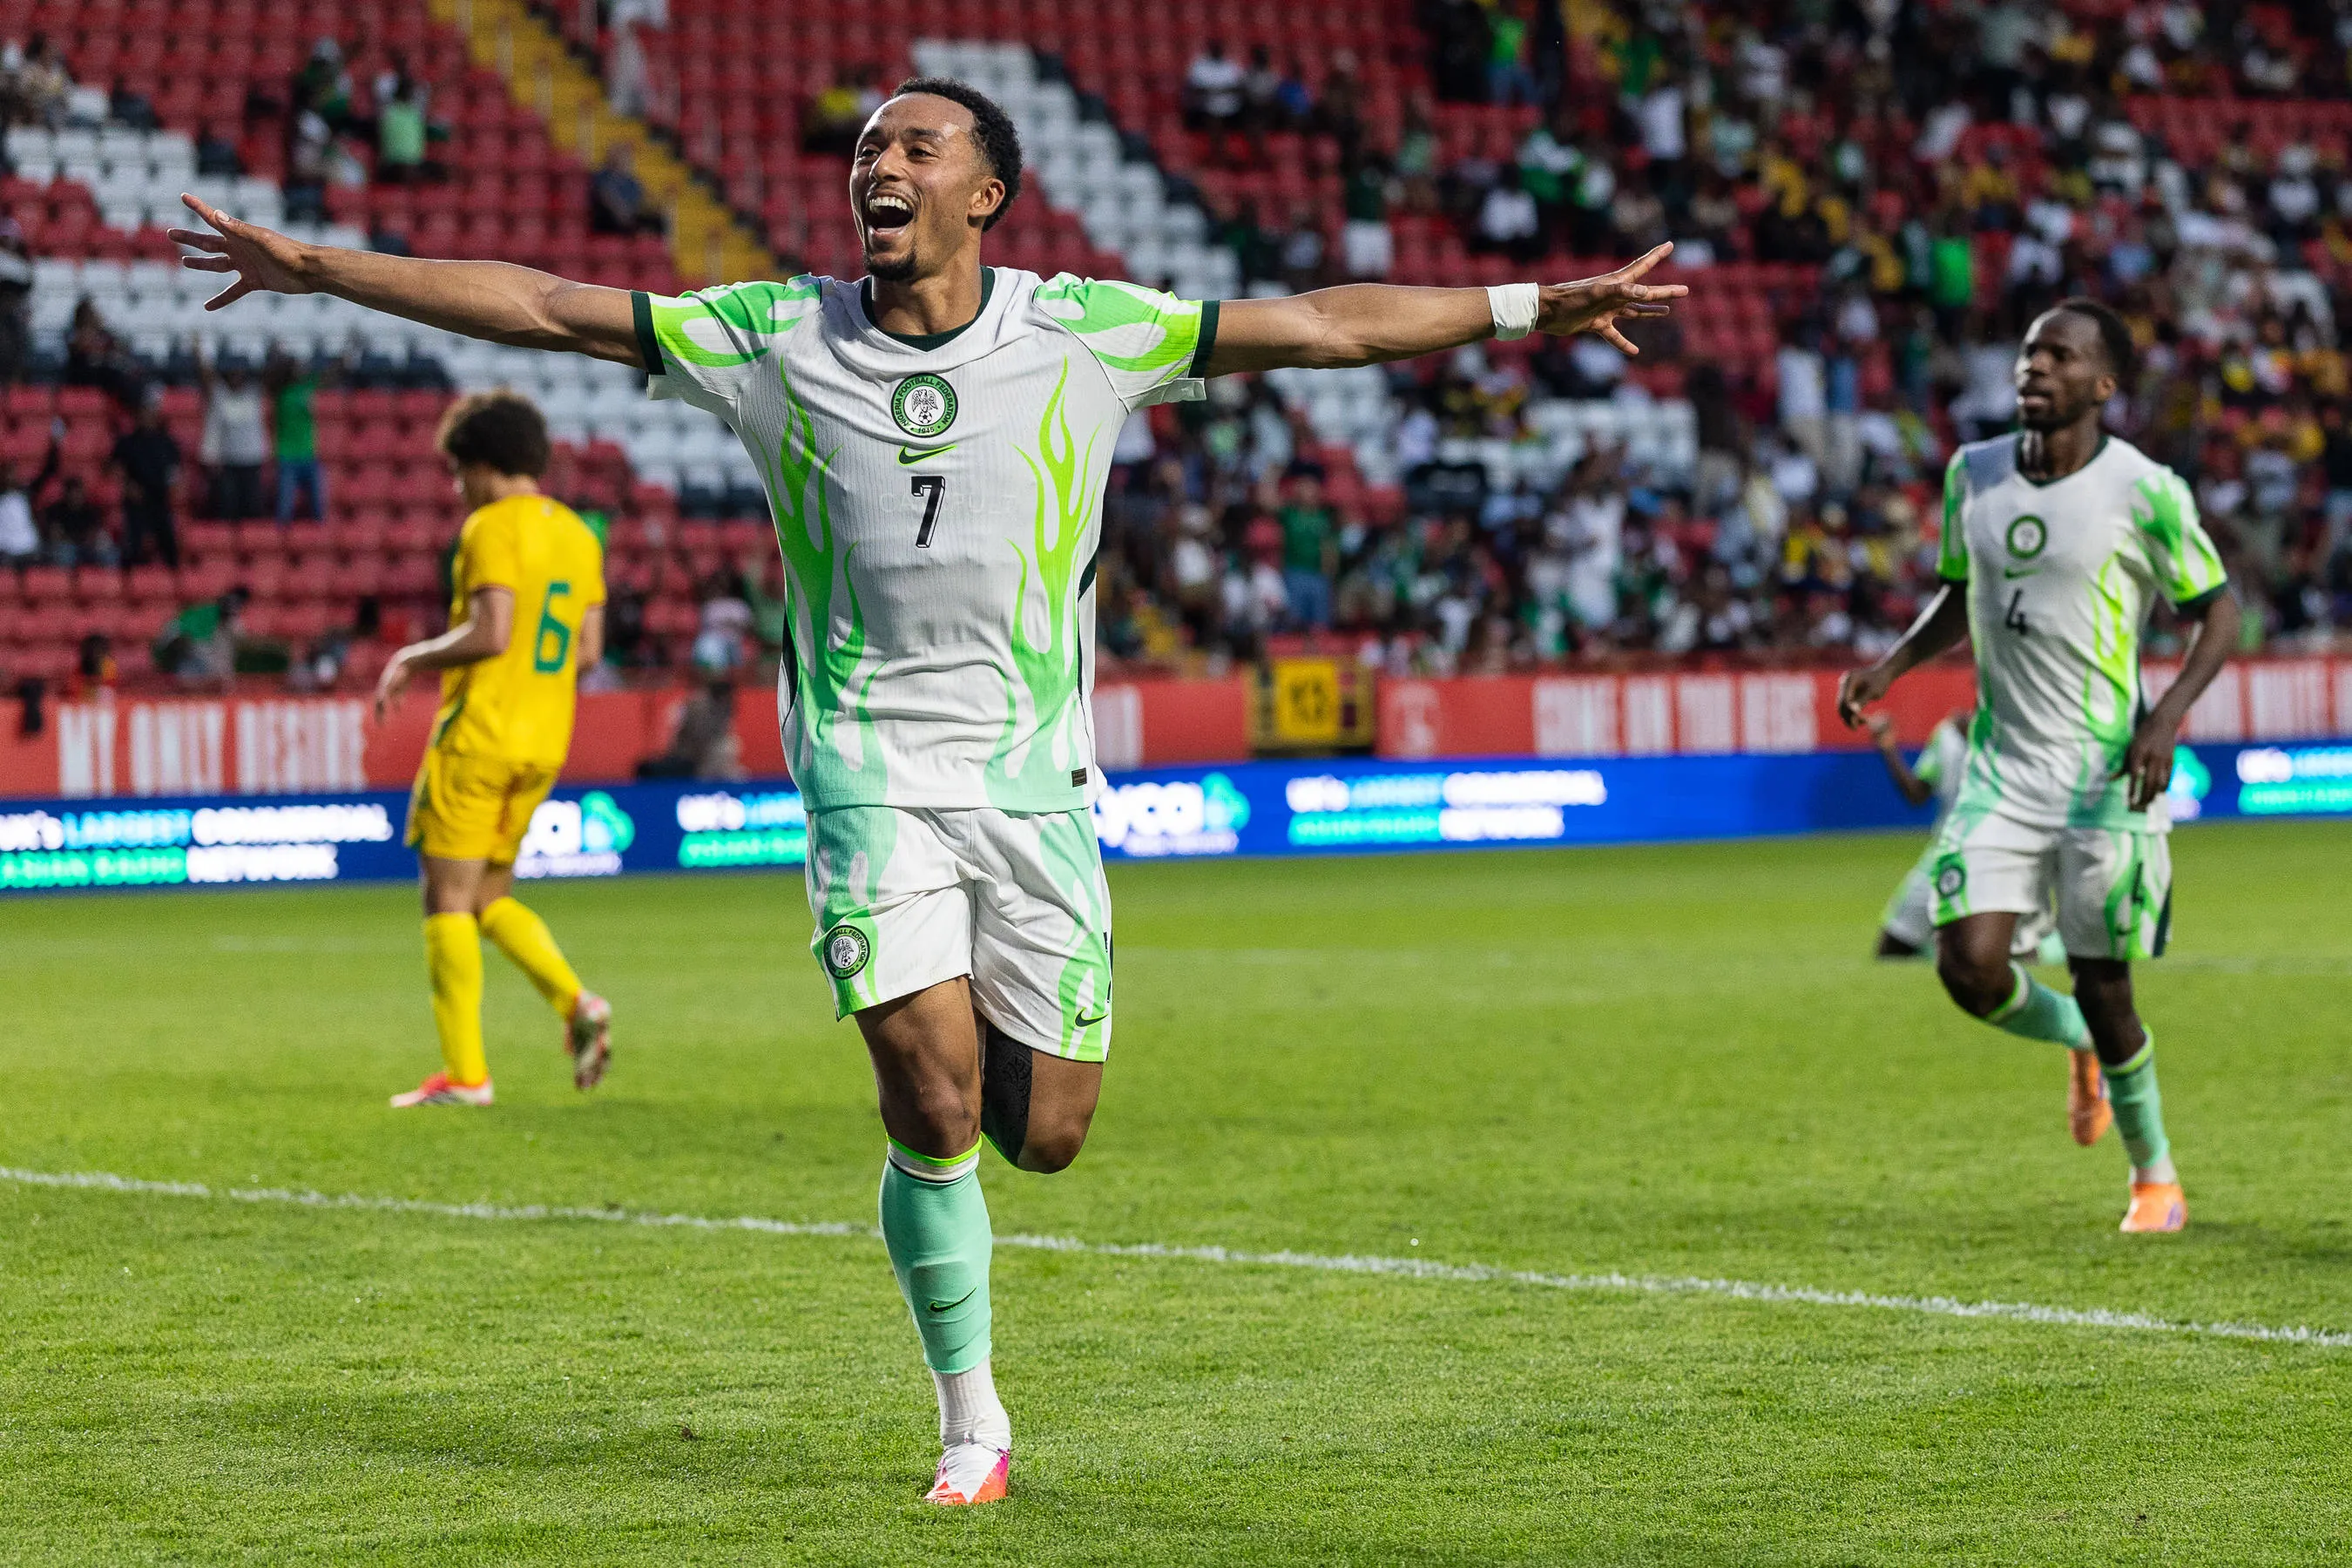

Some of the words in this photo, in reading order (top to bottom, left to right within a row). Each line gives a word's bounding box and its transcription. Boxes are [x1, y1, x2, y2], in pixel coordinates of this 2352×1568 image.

[898, 376, 934, 397] FOOTBALL
[935, 381, 954, 425] FEDERATION
[894, 397, 909, 427] NIGERIA
[911, 476, 945, 548] 7
[535, 581, 571, 673] 6
[2005, 587, 2028, 636] 4
[58, 702, 117, 797] MY
[131, 702, 225, 797] ONLY
[848, 929, 867, 963] FEDERATION
